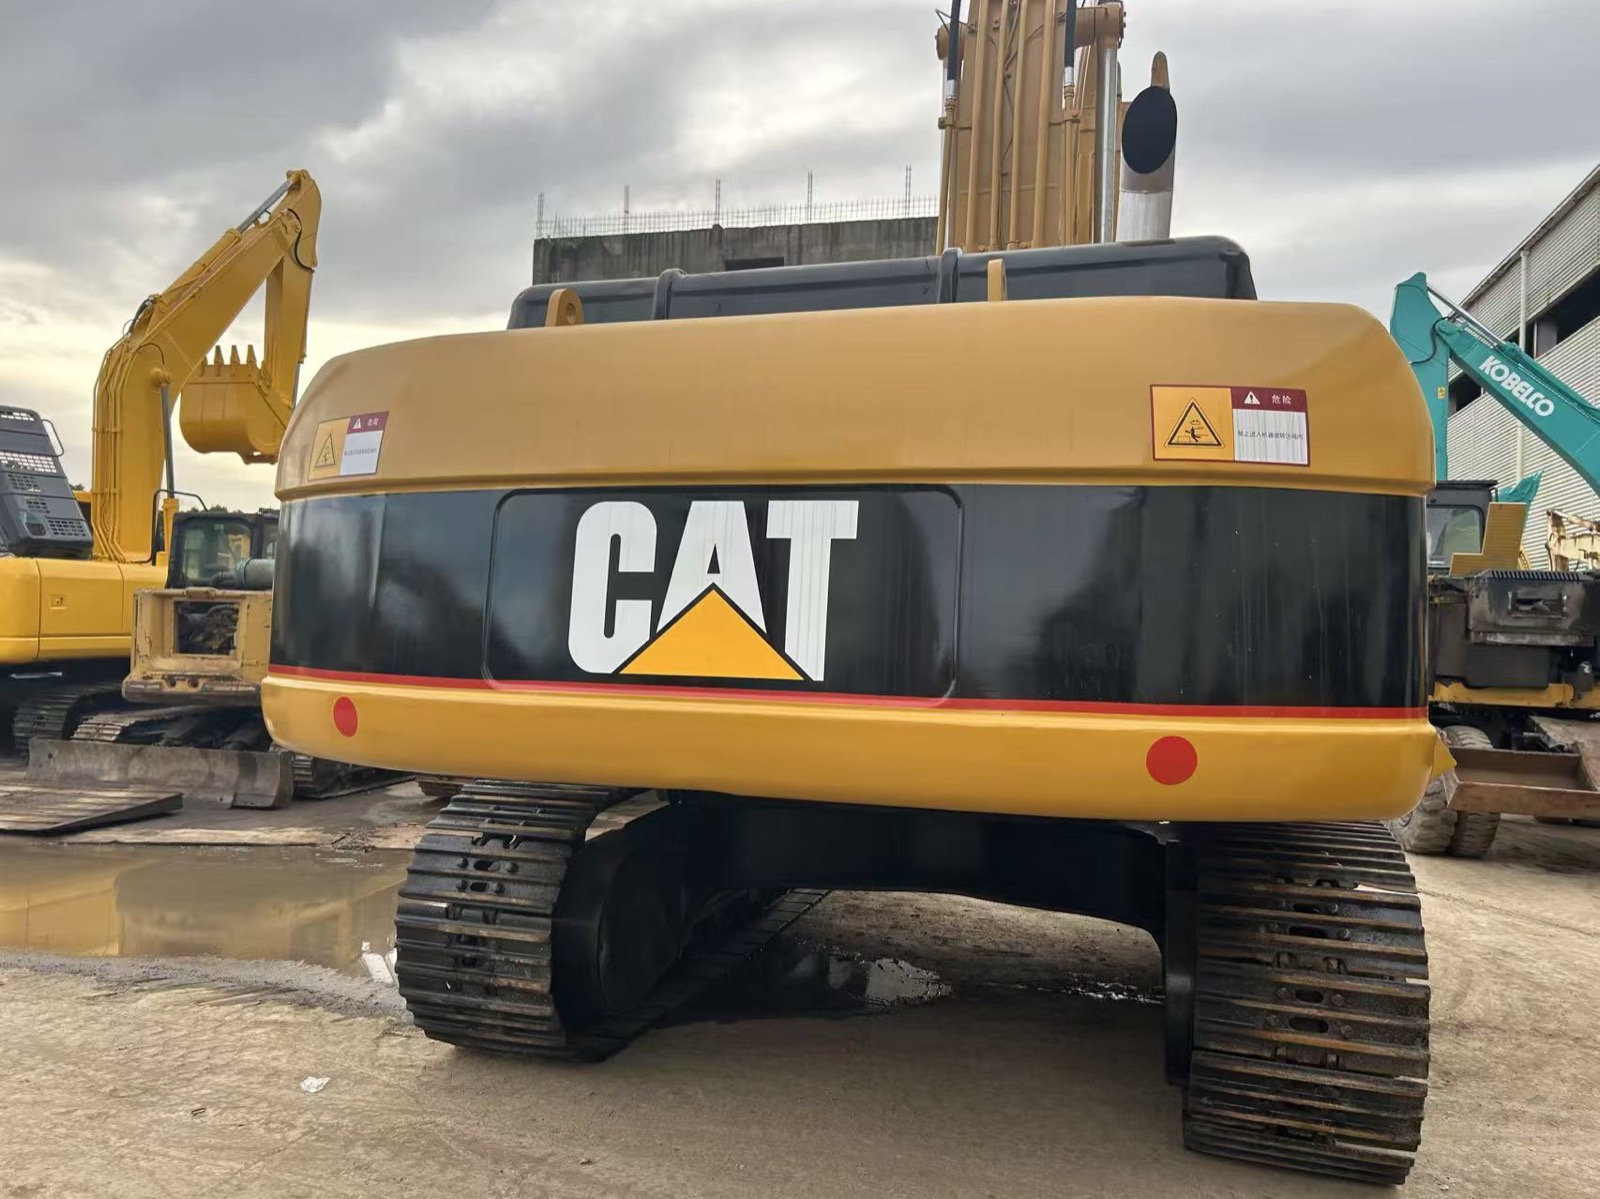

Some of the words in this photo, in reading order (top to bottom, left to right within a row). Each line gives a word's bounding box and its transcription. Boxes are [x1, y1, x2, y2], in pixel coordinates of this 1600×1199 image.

[1271, 394, 1292, 405] 危险
[1479, 355, 1555, 417] KOBELCO
[568, 500, 860, 682] CAT
